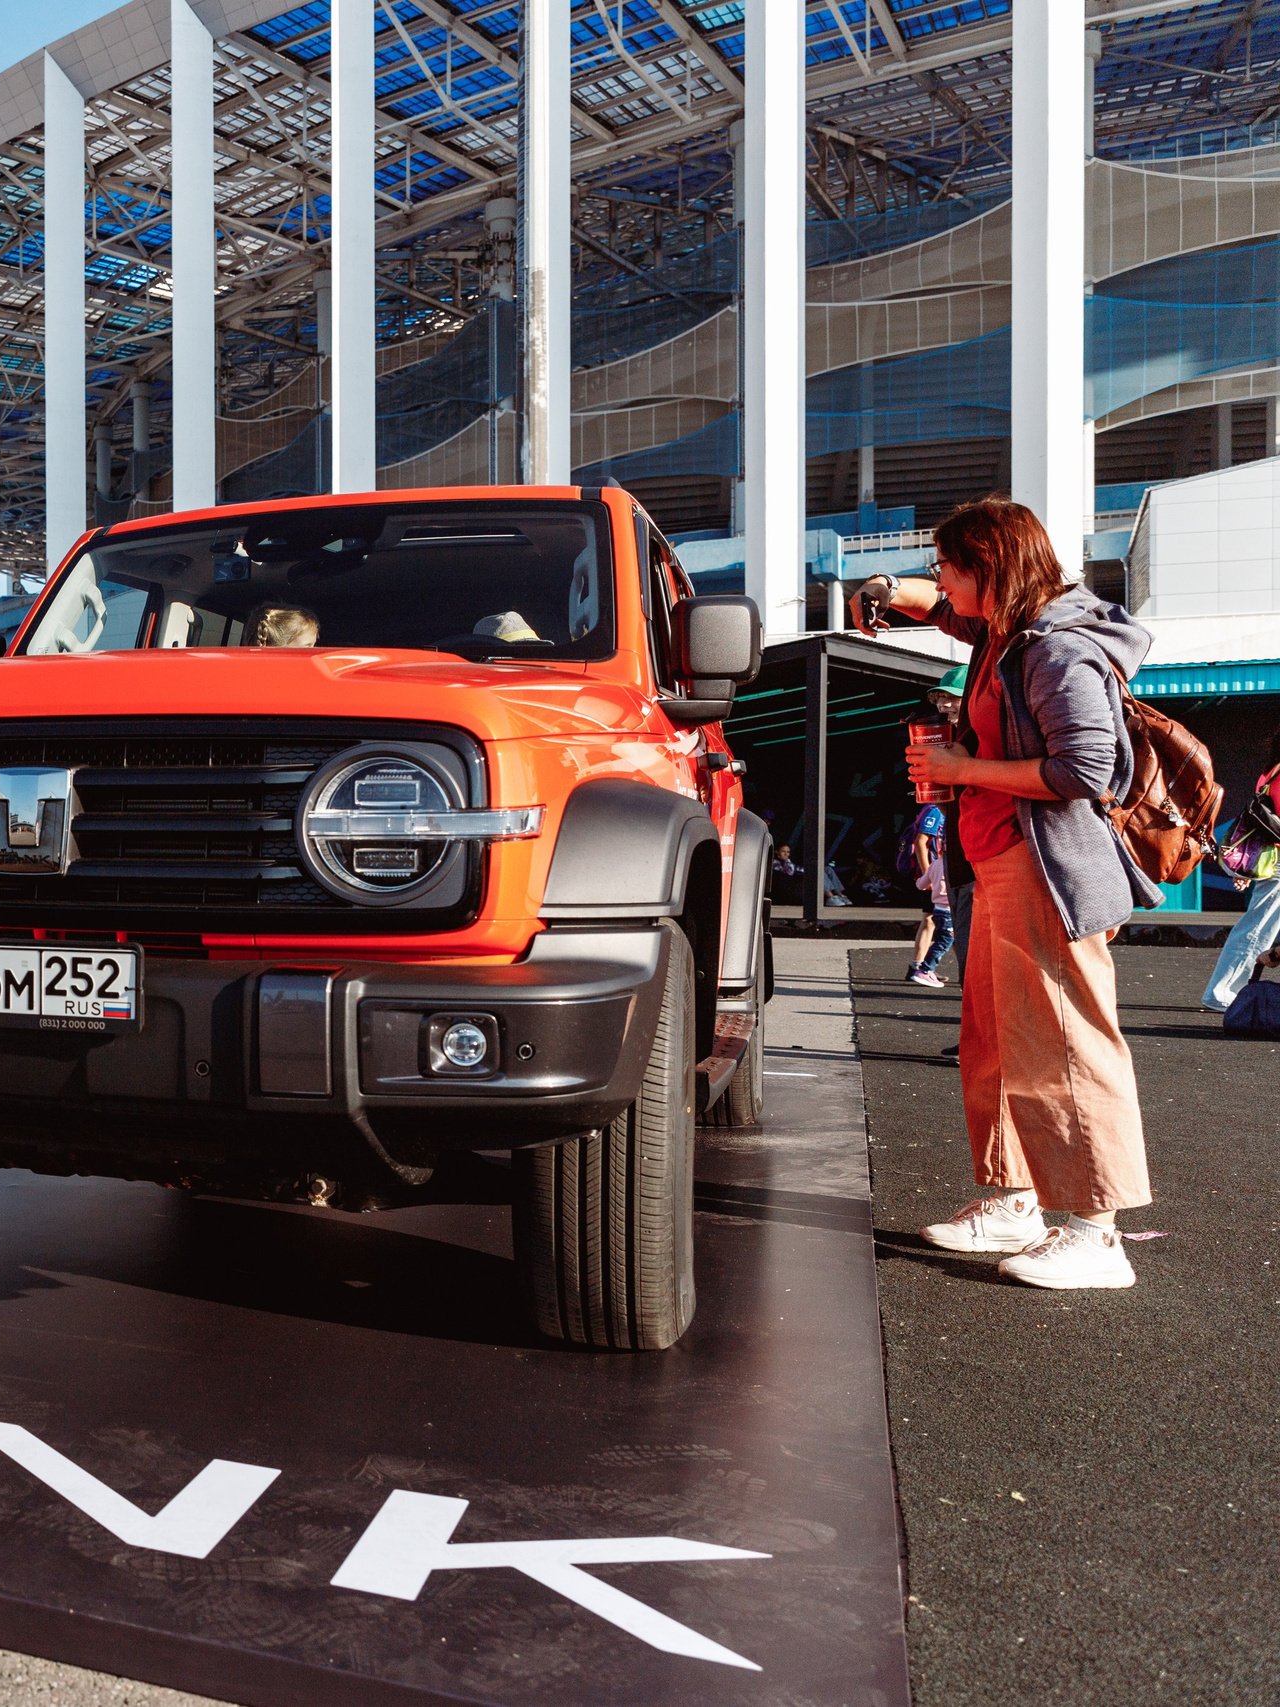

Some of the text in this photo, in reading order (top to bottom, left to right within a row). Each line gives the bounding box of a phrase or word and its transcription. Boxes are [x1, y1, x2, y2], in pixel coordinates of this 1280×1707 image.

[45, 956, 120, 999] 252
[64, 1000, 101, 1016] RUS
[39, 1018, 60, 1030] (831)
[87, 1021, 105, 1031] 000
